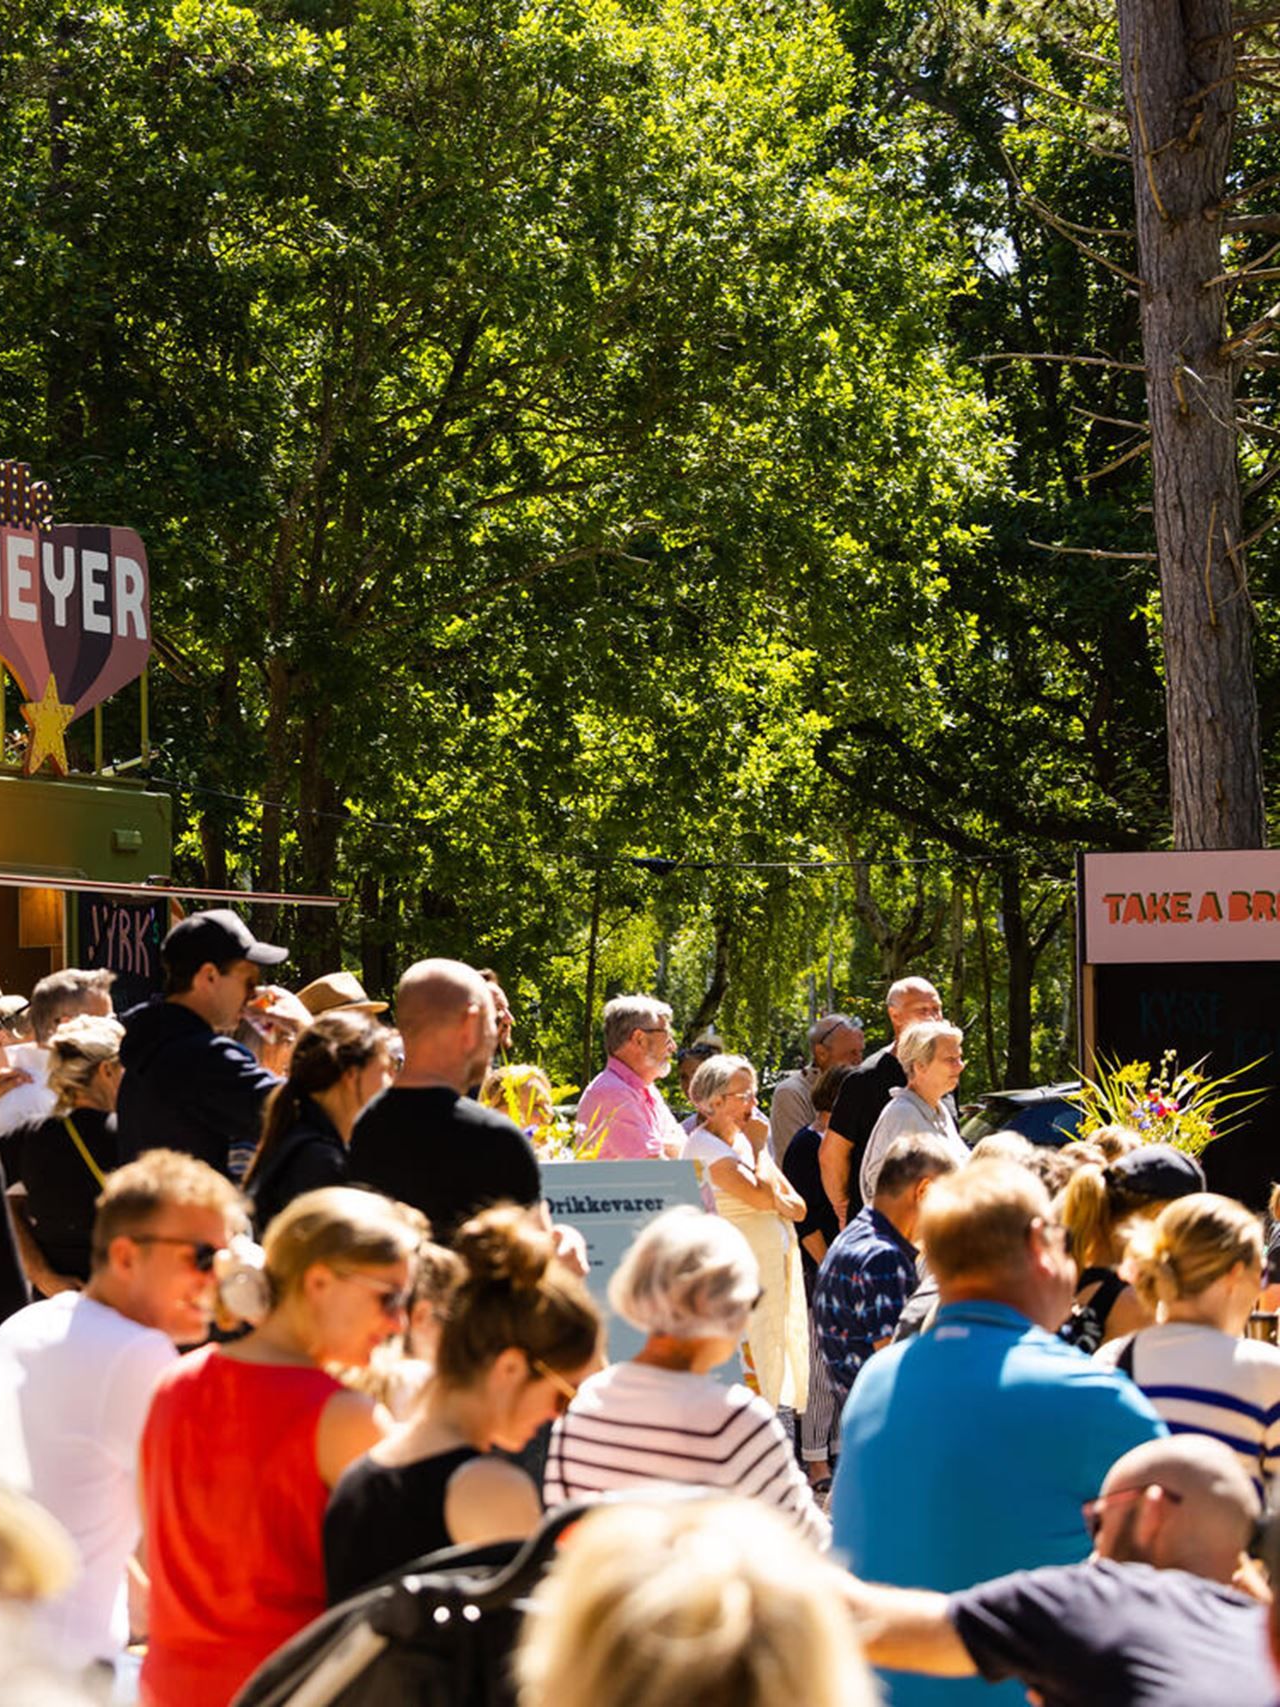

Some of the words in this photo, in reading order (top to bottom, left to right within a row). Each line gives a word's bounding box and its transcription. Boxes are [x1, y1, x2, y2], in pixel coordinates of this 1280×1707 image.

[1103, 892, 1191, 924] TAKE
[1197, 891, 1223, 923] A
[1228, 890, 1280, 922] BR
